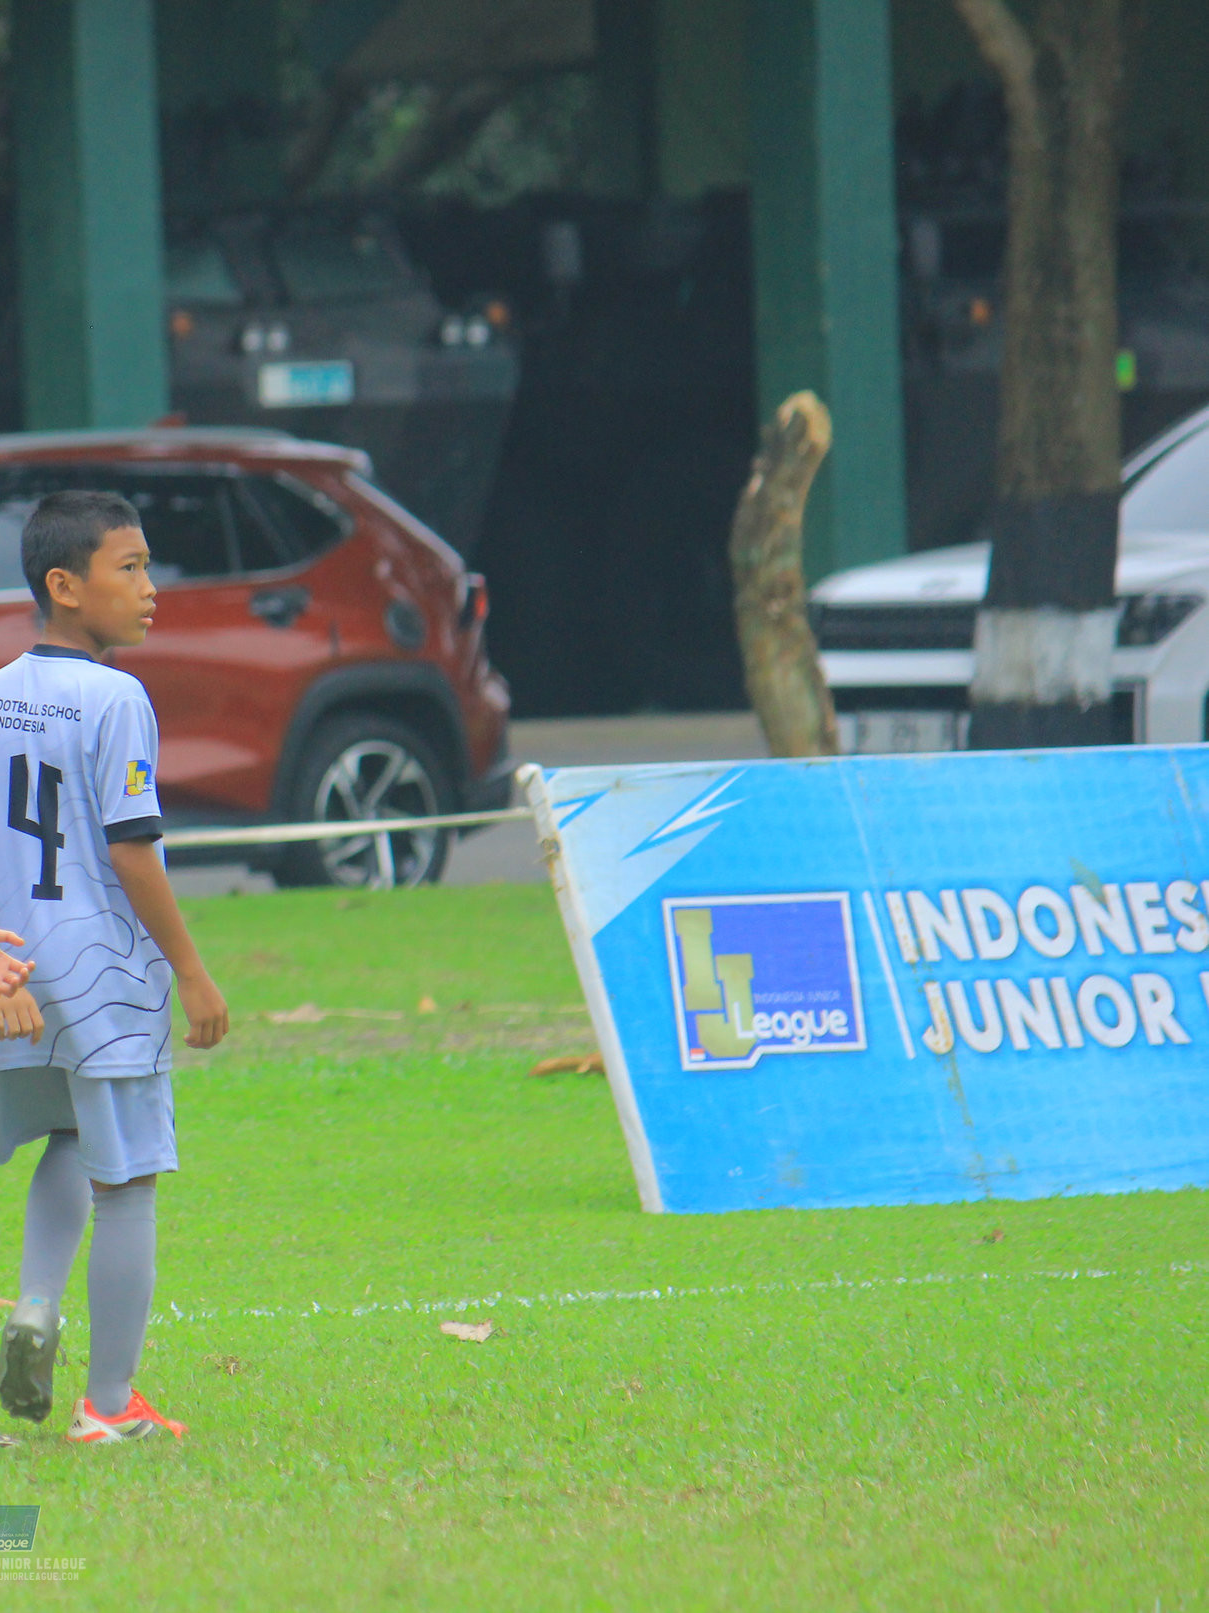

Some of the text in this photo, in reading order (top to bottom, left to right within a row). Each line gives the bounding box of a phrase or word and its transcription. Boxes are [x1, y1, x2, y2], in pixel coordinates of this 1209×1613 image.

[886, 879, 1209, 964] INDONES
[734, 1001, 849, 1046] League
[921, 973, 1192, 1056] JUNIOR
